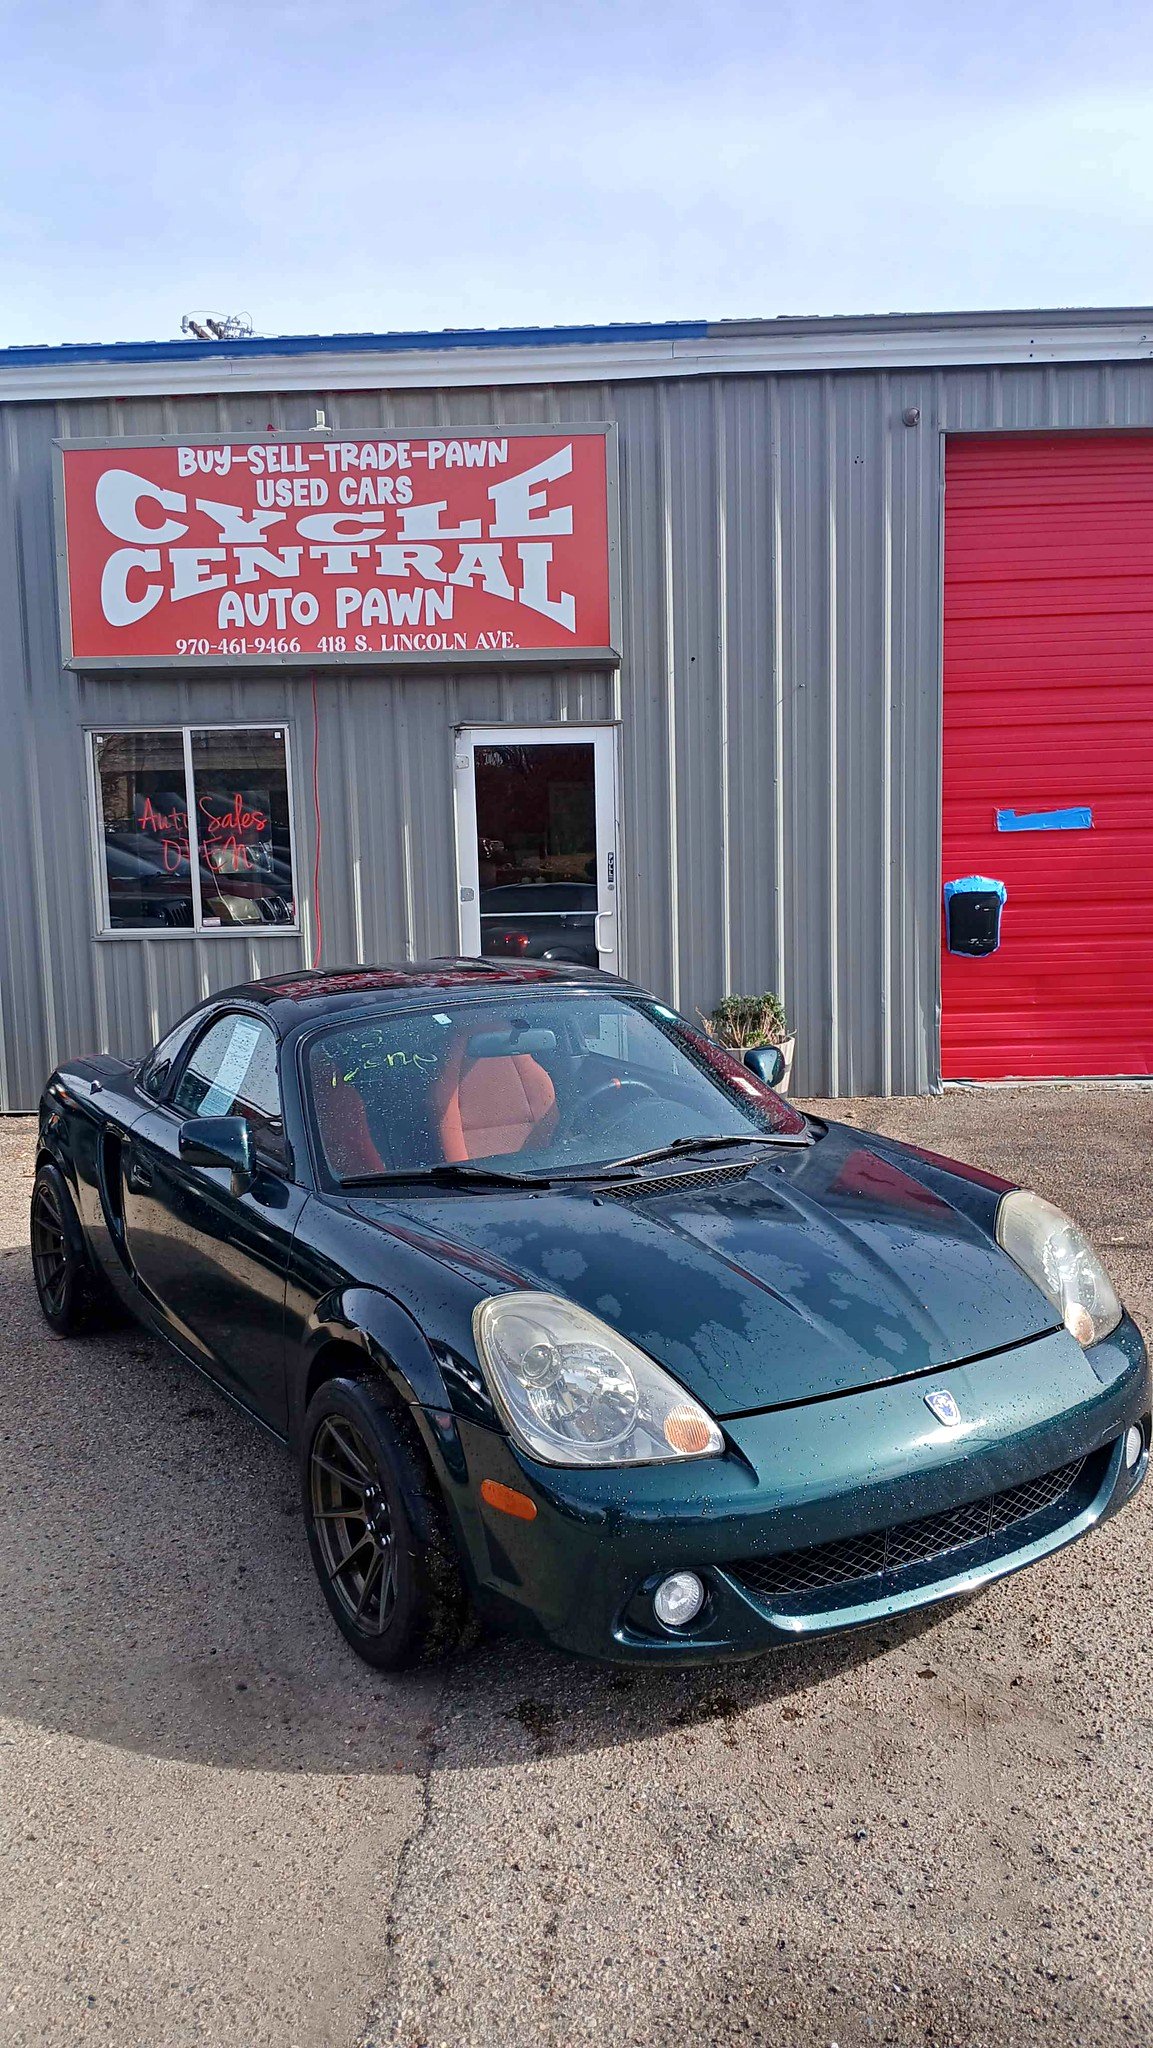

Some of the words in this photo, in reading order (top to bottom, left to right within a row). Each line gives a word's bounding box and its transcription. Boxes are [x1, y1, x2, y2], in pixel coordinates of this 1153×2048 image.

[177, 439, 508, 477] BUY-SELL-TRADE-PAWN
[95, 443, 574, 545] CYCLE
[256, 478, 329, 508] USED
[339, 475, 413, 506] CARS
[101, 541, 576, 633] CENTRAL
[217, 588, 319, 630] AUTO
[336, 585, 454, 629] PAWN
[175, 637, 301, 655] 970-461-9466
[317, 636, 346, 653] 418
[355, 634, 373, 652] S.
[381, 632, 467, 651] LINCOLN
[475, 630, 520, 649] AVE.
[138, 797, 190, 833] Aut
[199, 792, 268, 835] Sales
